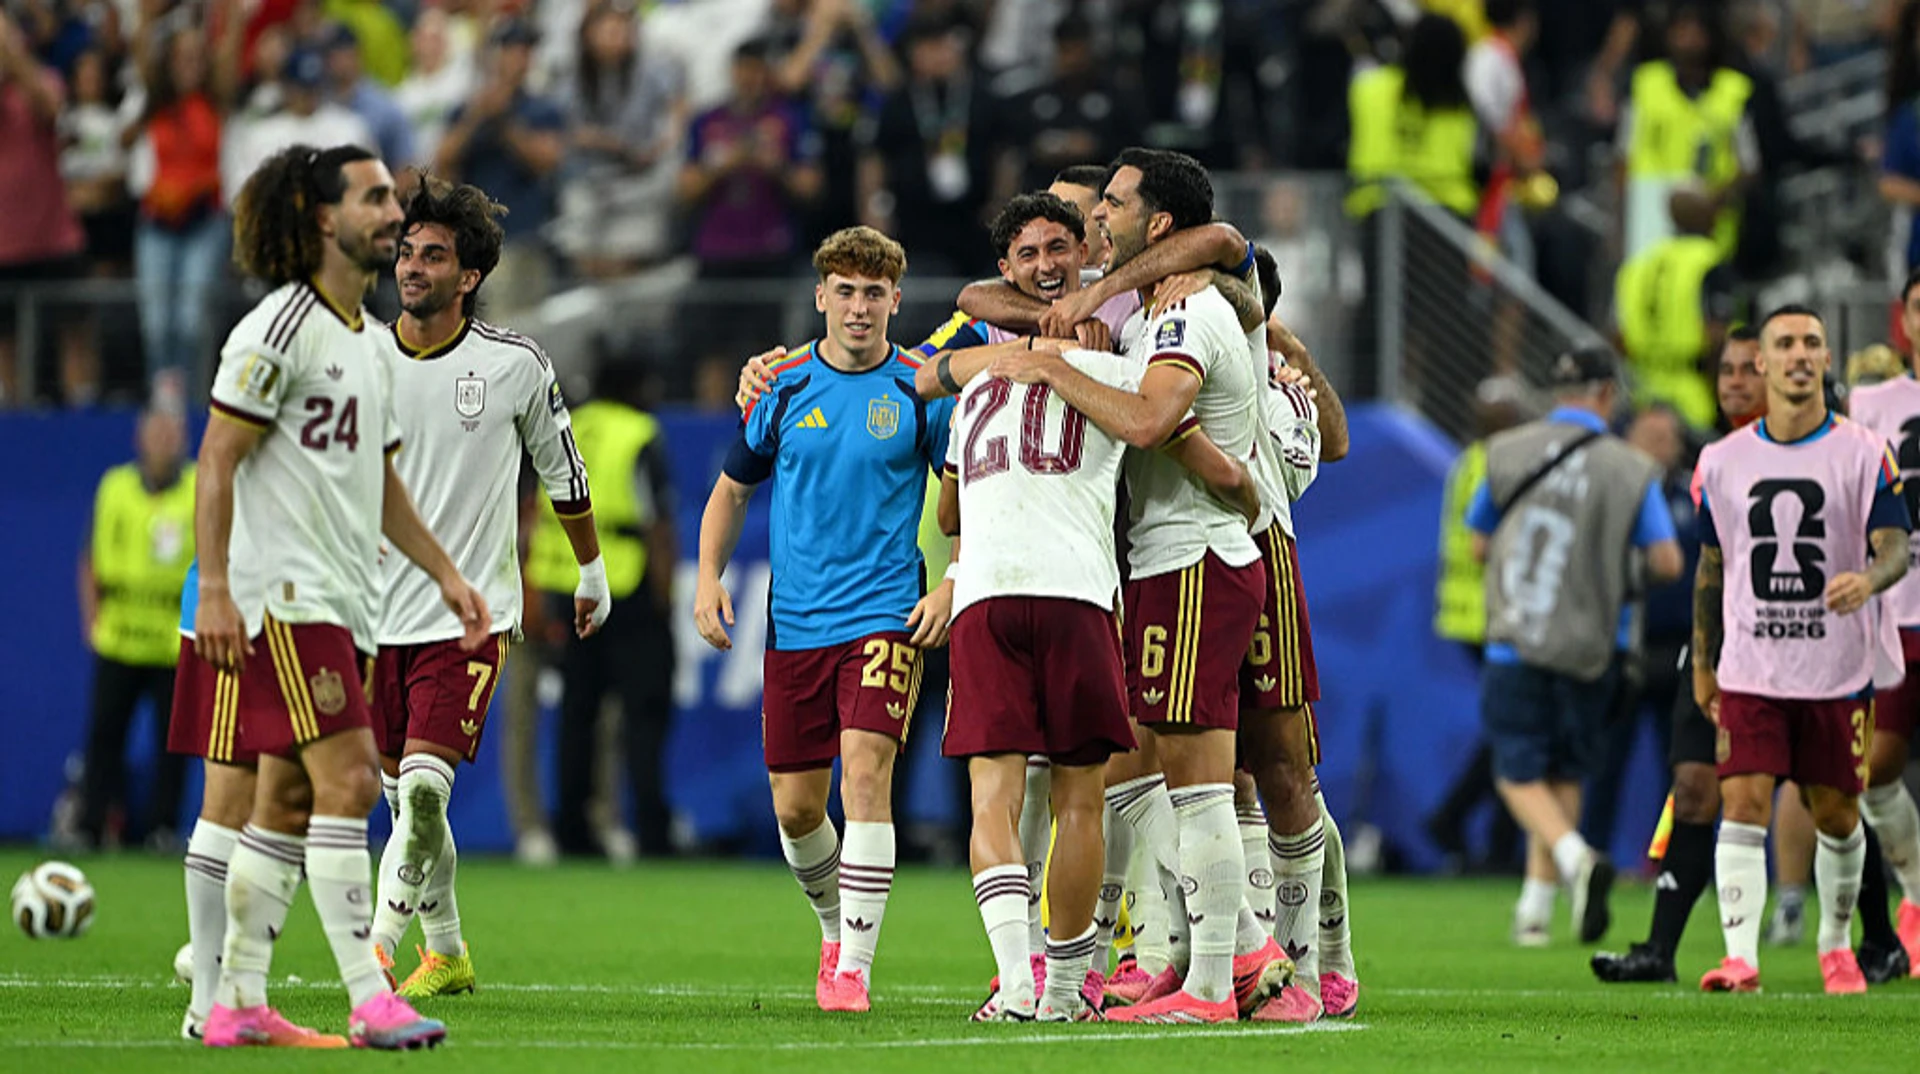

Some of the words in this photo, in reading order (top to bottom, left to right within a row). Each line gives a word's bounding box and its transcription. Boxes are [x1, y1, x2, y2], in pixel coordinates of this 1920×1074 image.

[301, 395, 358, 452] 24
[963, 376, 1087, 488] 20
[1769, 576, 1805, 593] FIFA
[1754, 621, 1826, 639] 2026
[1799, 607, 1825, 619] CUP
[861, 638, 916, 694] 25
[1141, 625, 1168, 678] 6
[467, 660, 493, 711] 7
[1850, 708, 1865, 757] 3
